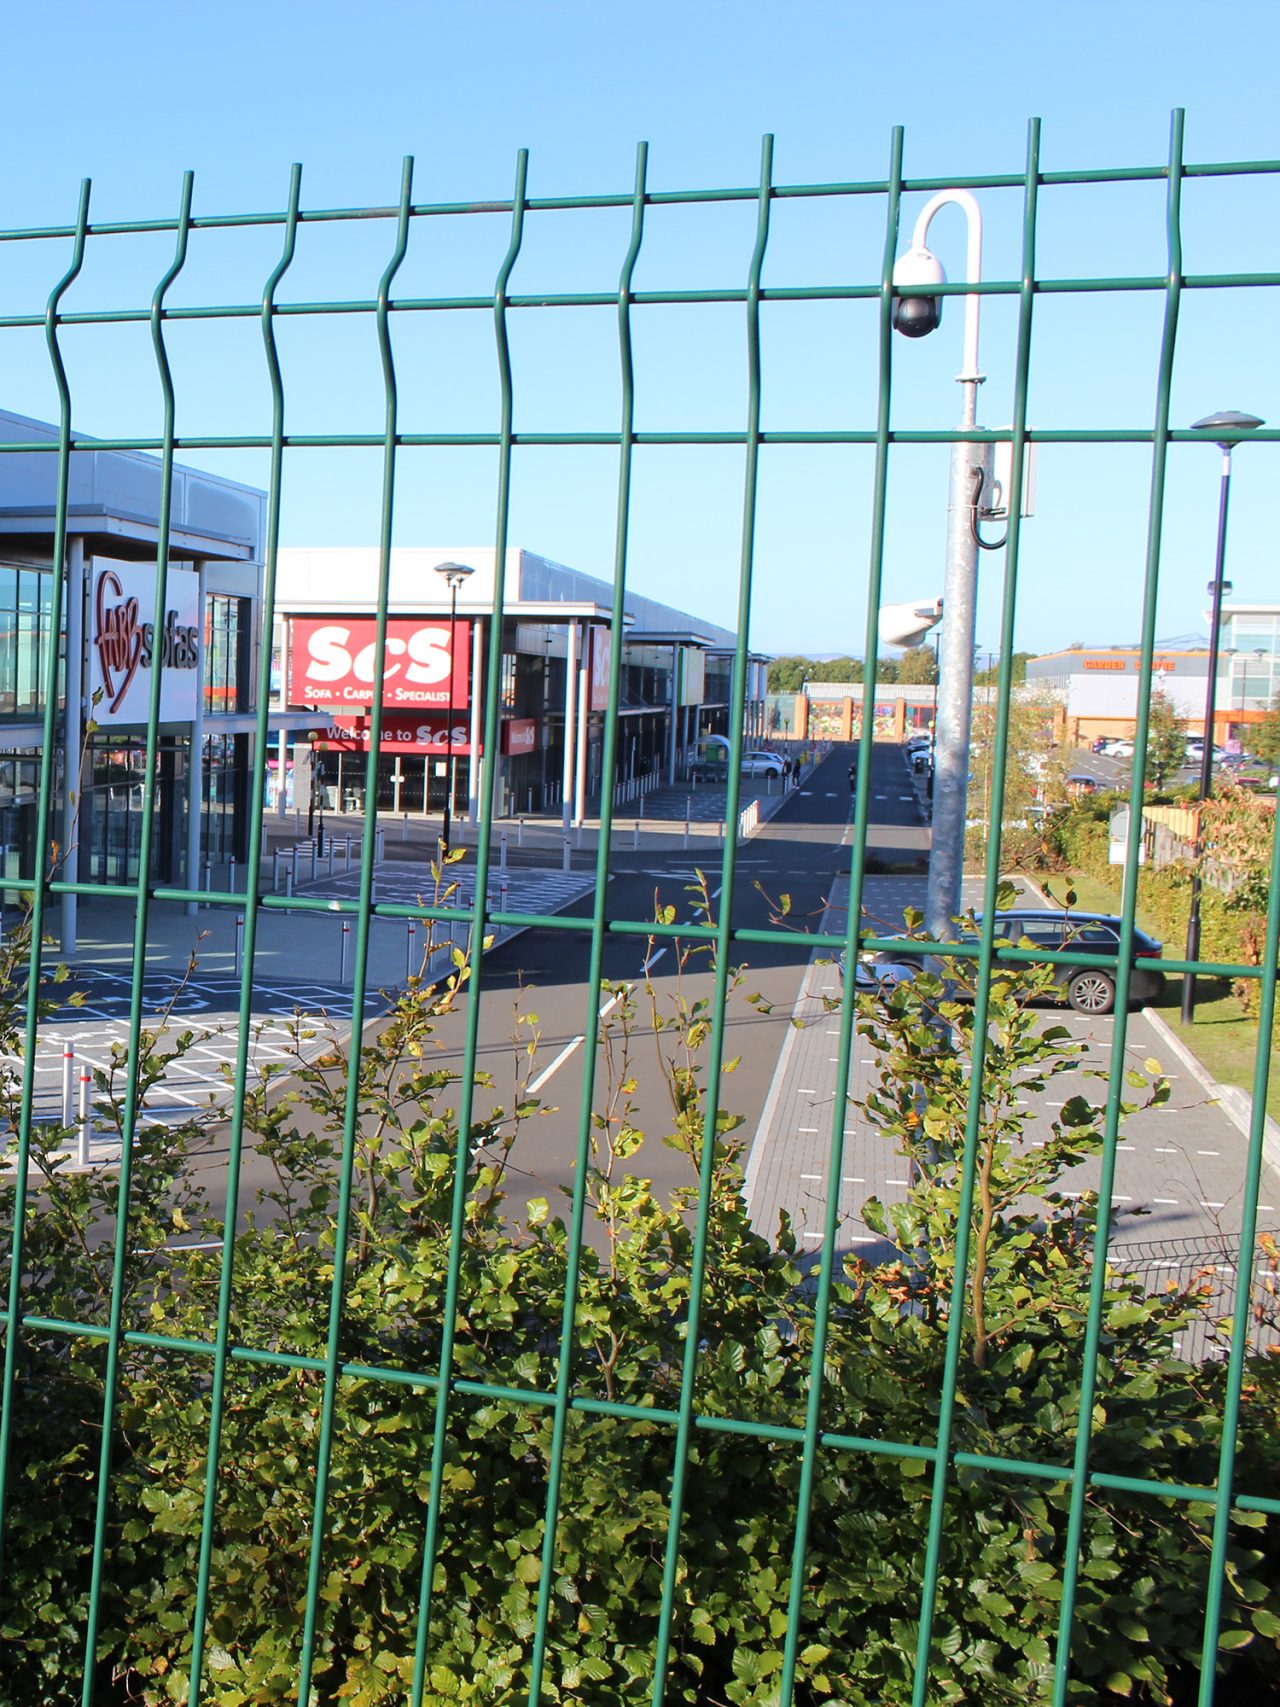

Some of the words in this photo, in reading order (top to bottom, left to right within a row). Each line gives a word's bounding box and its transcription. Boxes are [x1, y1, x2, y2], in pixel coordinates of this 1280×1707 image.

[305, 626, 452, 684] ScS
[1083, 659, 1126, 670] GARDEN
[1134, 660, 1175, 671] CTRE
[343, 686, 384, 700] CARP
[326, 726, 393, 741] Welcoe
[397, 729, 412, 741] to
[415, 725, 468, 746] ScS
